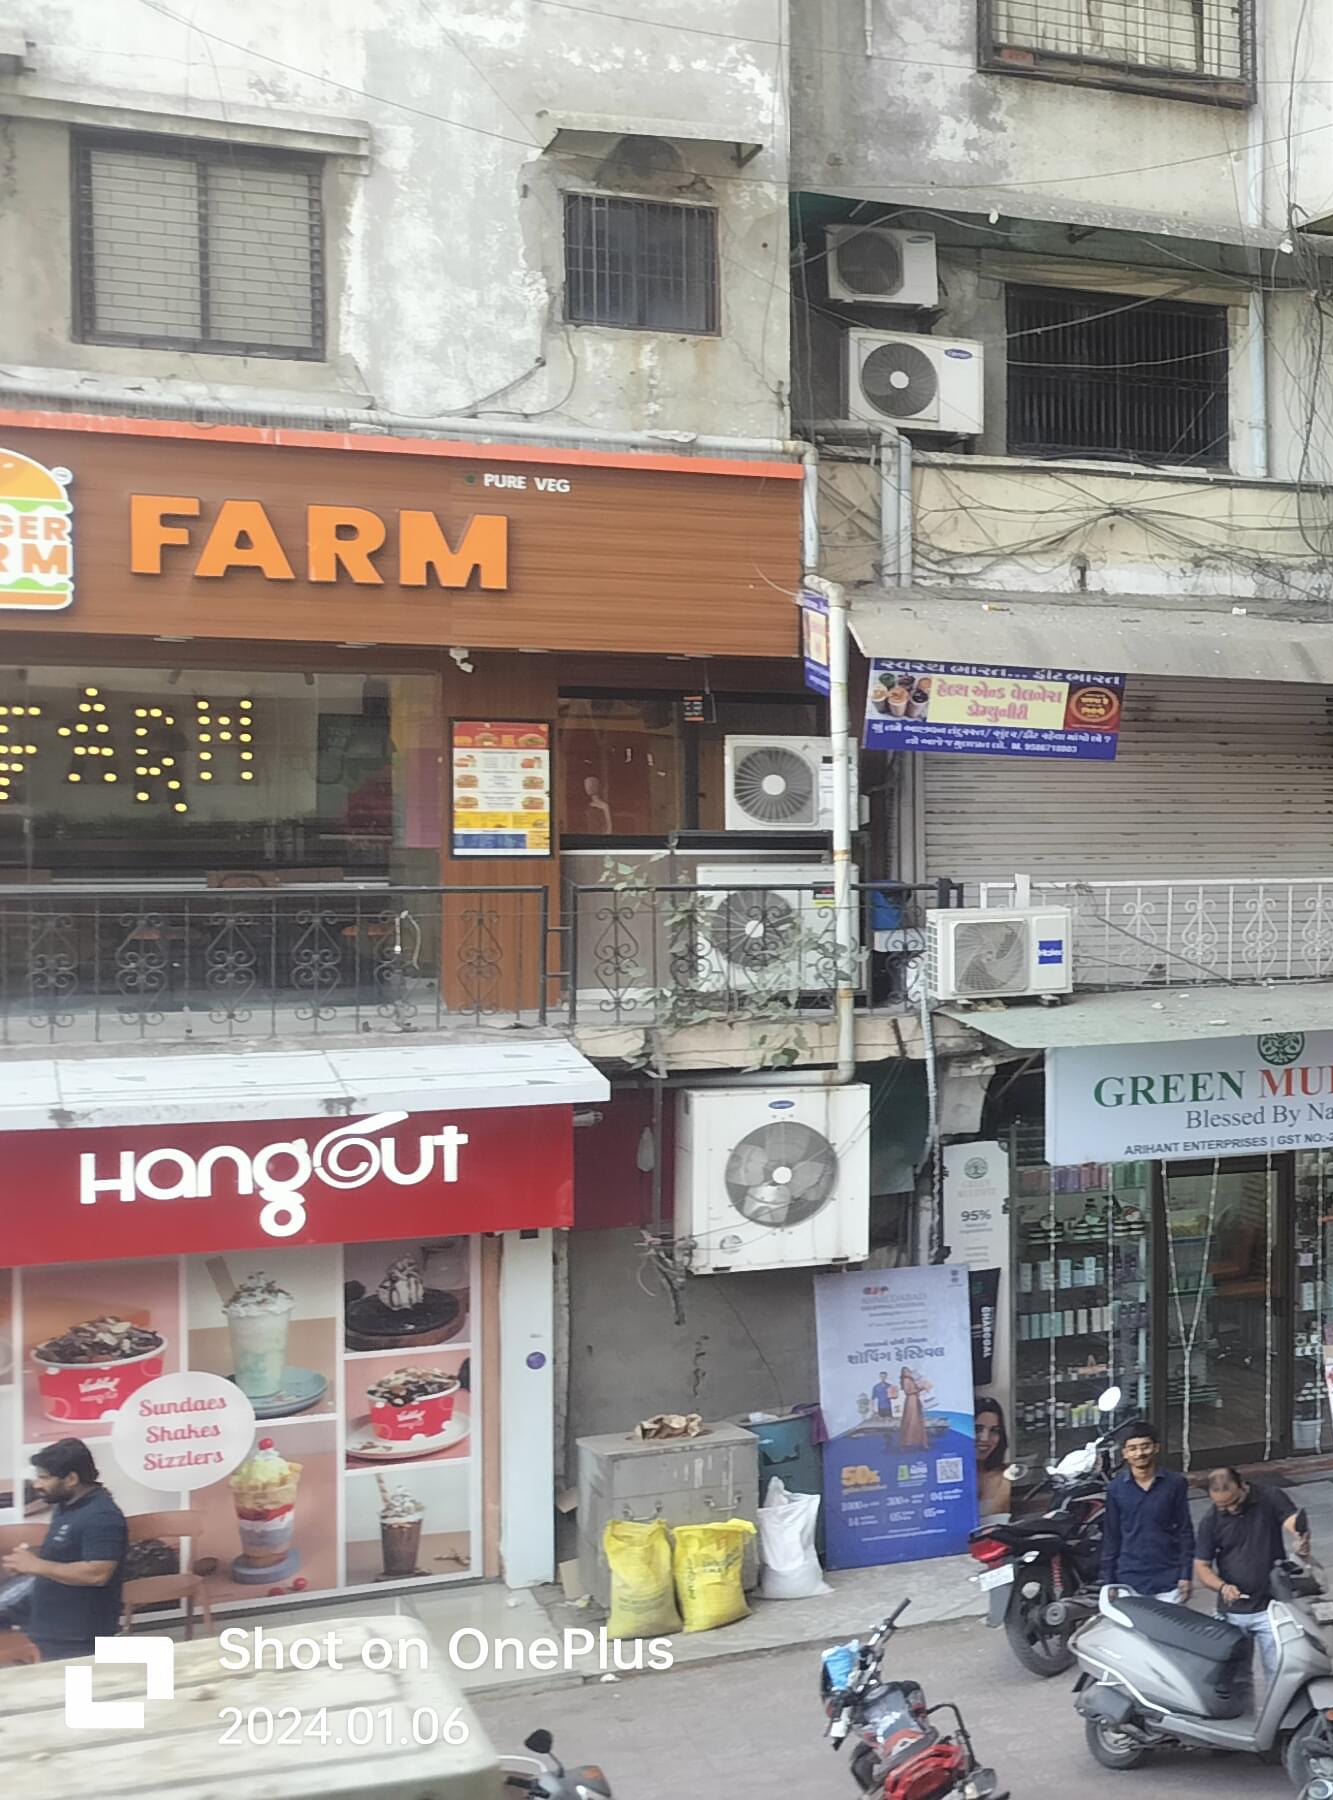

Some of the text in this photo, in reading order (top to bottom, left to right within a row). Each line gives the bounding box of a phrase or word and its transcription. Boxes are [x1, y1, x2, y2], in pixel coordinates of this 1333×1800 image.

[484, 473, 571, 494] PURE VEG
[129, 493, 509, 591] FARM
[1093, 1070, 1244, 1109] GREEN
[1185, 1108, 1266, 1130] Blessed
[1271, 1104, 1300, 1126] By
[1123, 1141, 1180, 1156] ARIHANT
[1182, 1135, 1268, 1152] ENTERPRISES
[1276, 1131, 1301, 1146] GST
[960, 1208, 992, 1223] 95%
[138, 1394, 229, 1418] Sundaes
[145, 1423, 222, 1445] Shakes
[143, 1448, 226, 1472] Sizzlers
